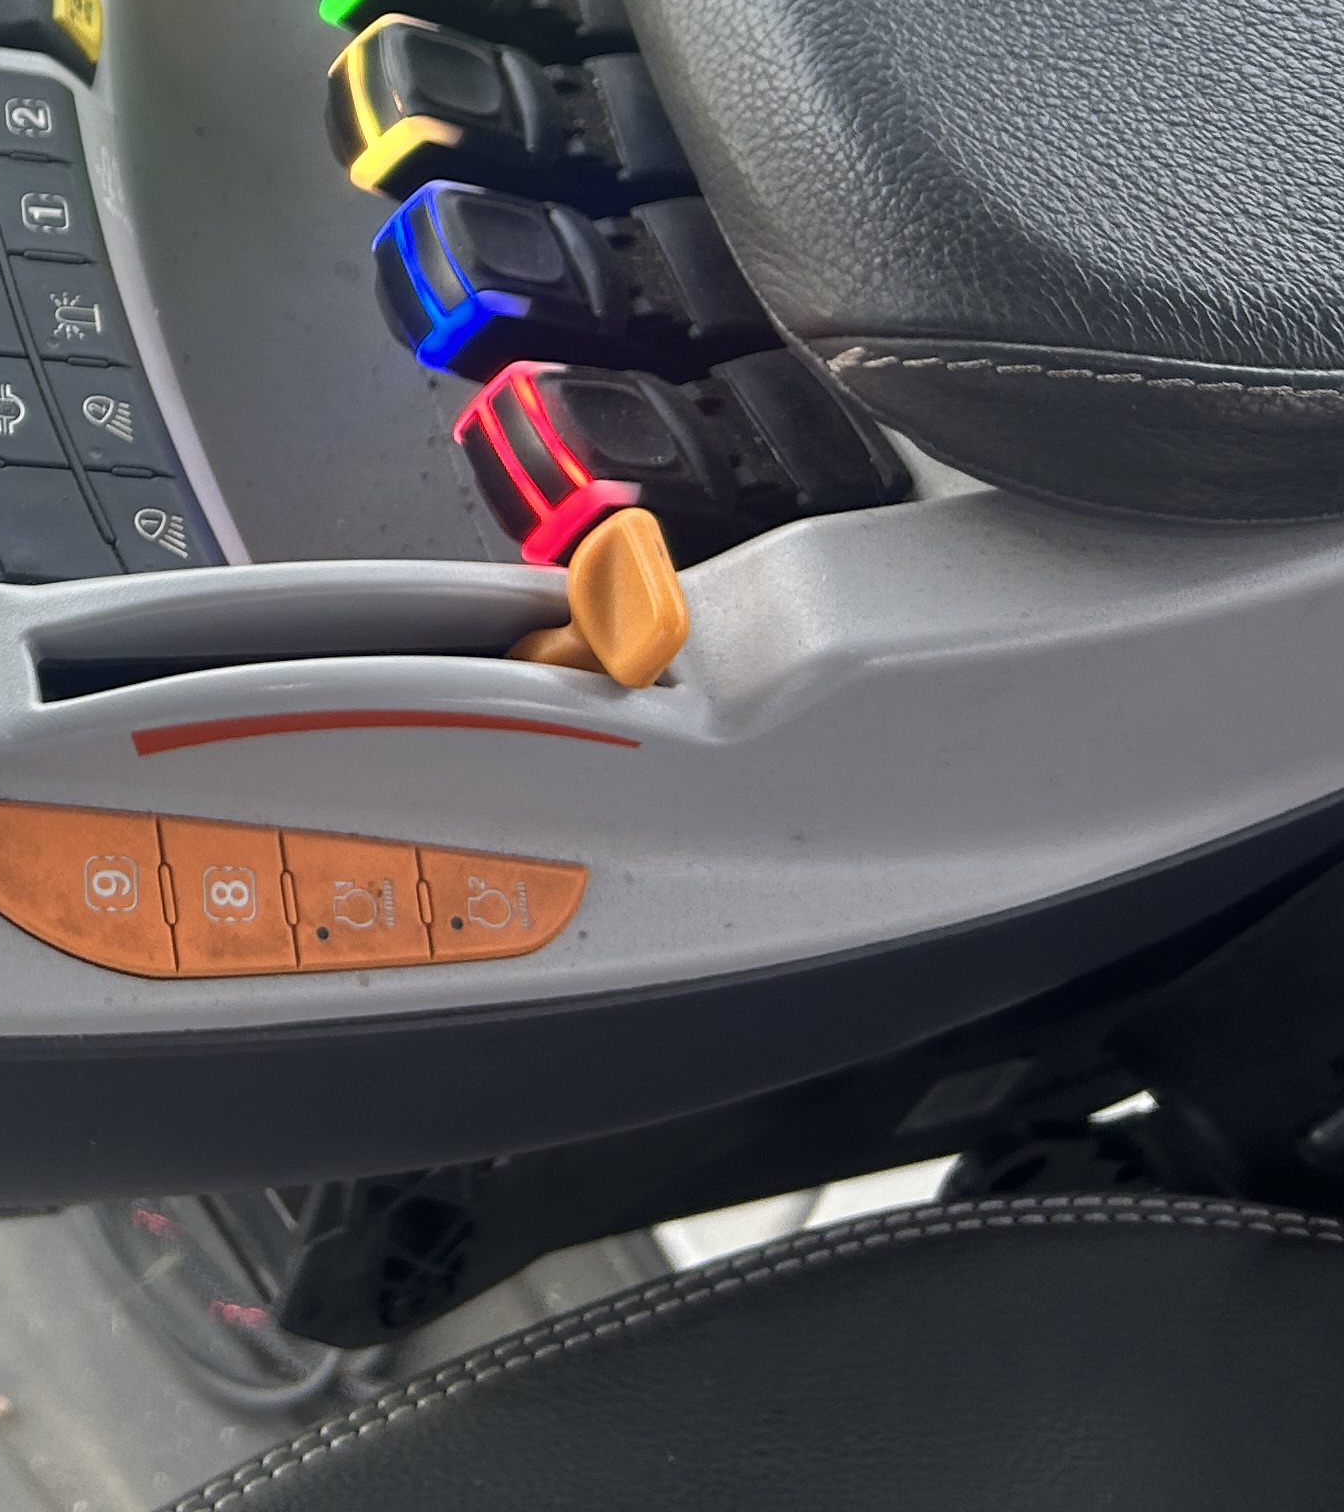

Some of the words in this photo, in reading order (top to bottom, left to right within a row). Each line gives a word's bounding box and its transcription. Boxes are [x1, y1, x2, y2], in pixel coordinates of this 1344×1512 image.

[14, 106, 45, 129] 2
[29, 203, 64, 220] 1
[92, 870, 131, 896] 9
[211, 879, 248, 906] 8
[468, 876, 486, 889] 2
